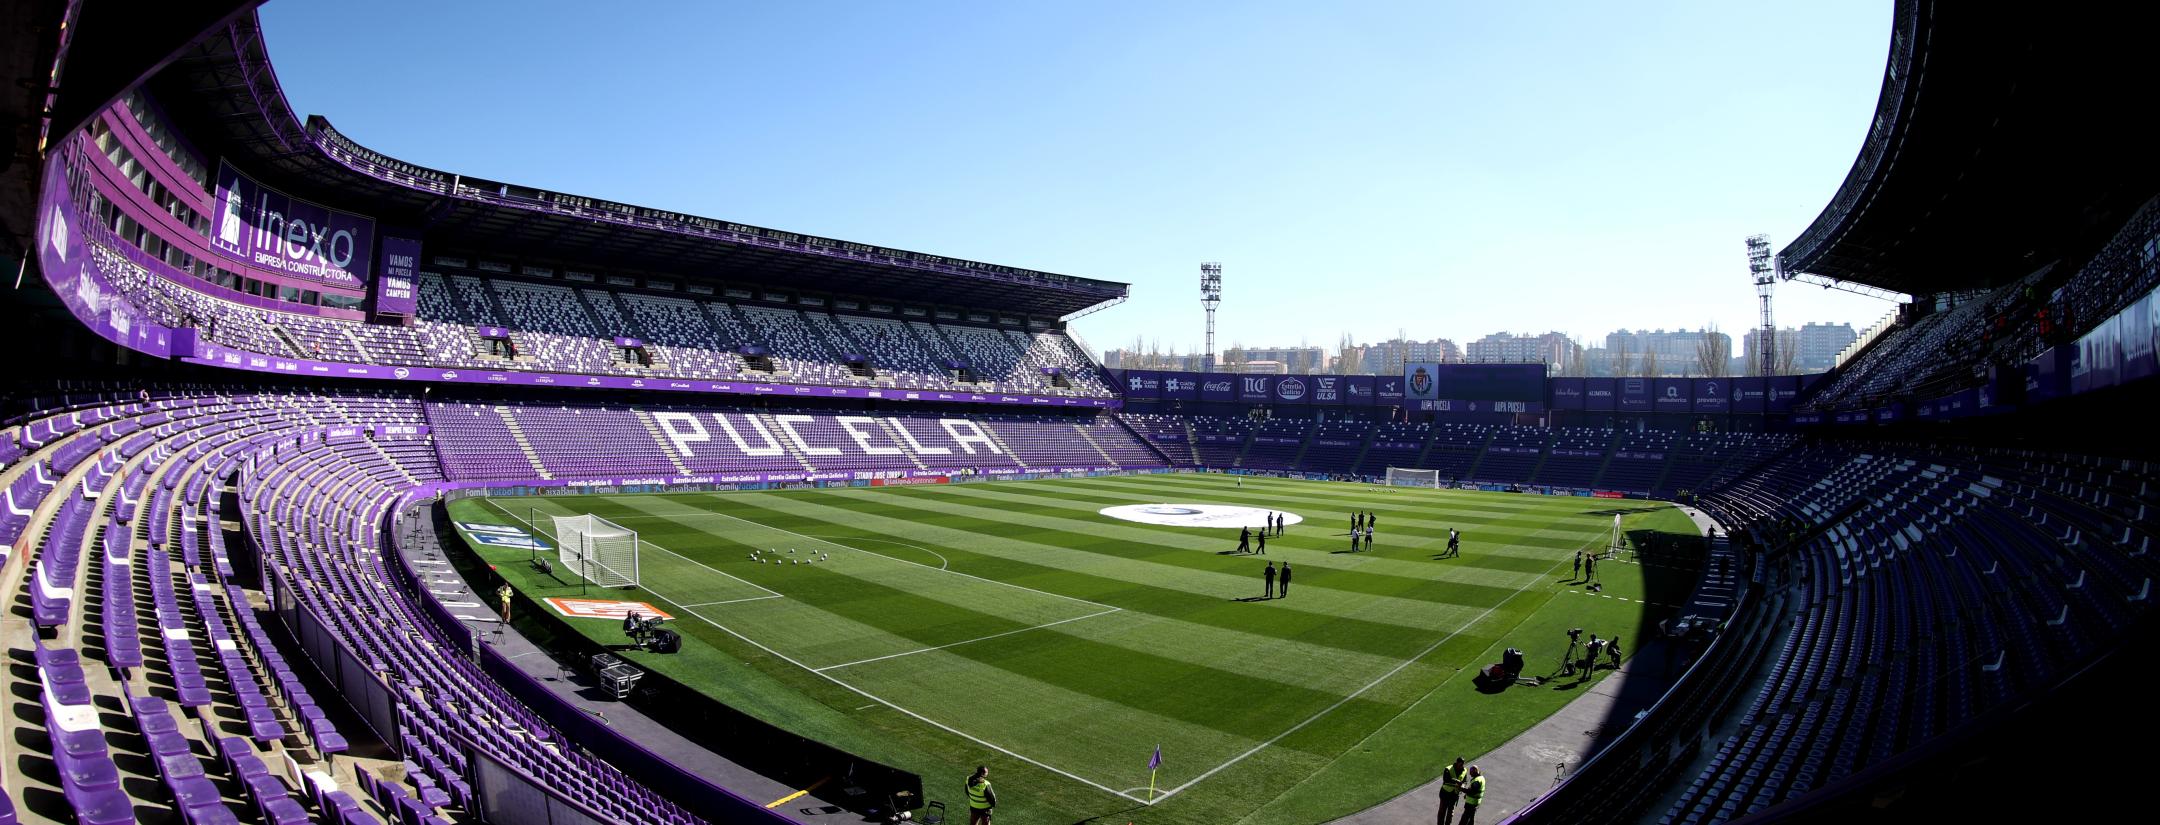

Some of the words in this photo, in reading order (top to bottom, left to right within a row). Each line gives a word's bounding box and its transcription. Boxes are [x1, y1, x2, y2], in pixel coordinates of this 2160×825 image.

[255, 251, 287, 270] EMPRESA
[288, 260, 352, 282] CONSTRUCTORA
[389, 254, 413, 268] VAMOS
[387, 266, 395, 275] MI
[395, 267, 412, 277] PUCELA
[387, 276, 411, 290] VAMOS
[1316, 392, 1337, 400] ULSA
[1433, 400, 1451, 411] PUCELA
[1507, 401, 1526, 413] PUCELA
[652, 411, 1004, 457] PUCELA
[854, 471, 873, 480] ESTADIO
[588, 479, 607, 487] Galicia
[662, 483, 701, 493] CaixaBank
[538, 486, 578, 496] CaixaBank
